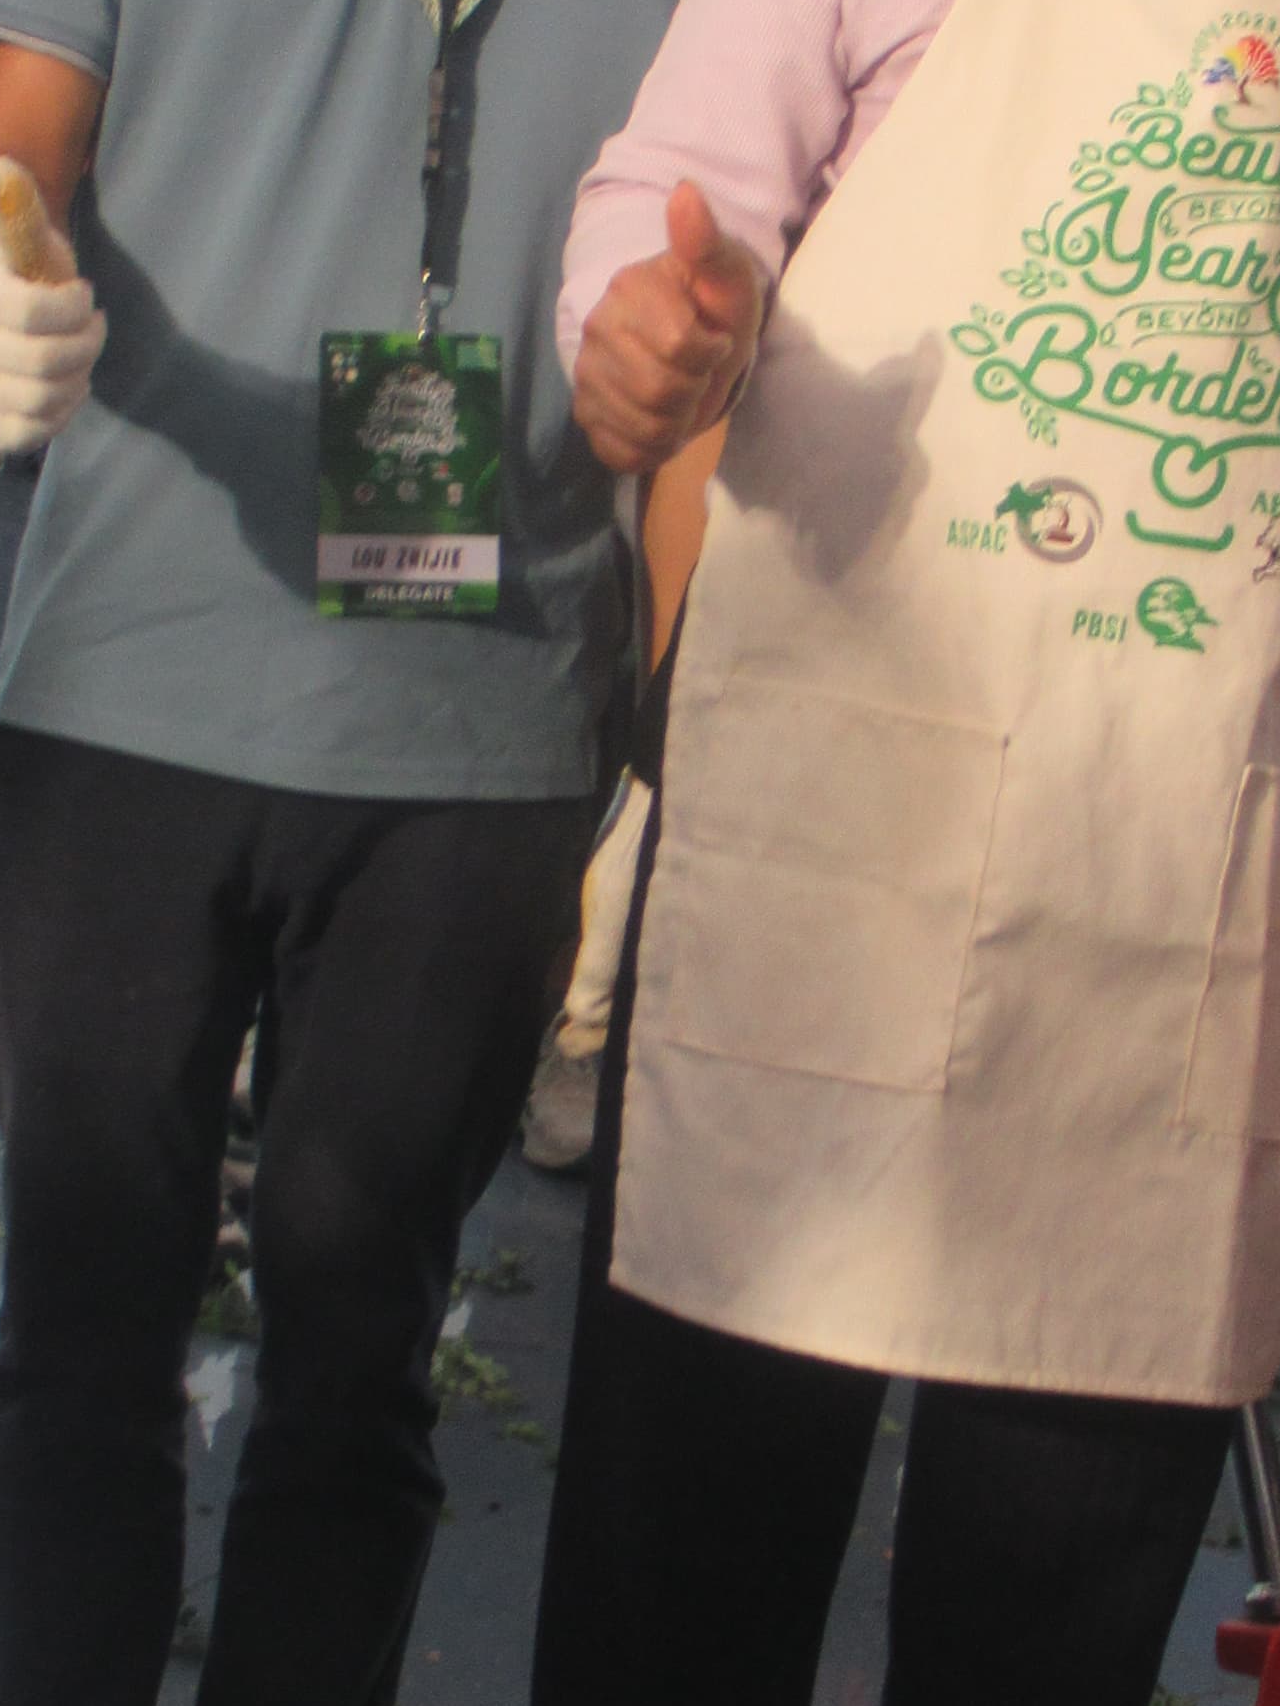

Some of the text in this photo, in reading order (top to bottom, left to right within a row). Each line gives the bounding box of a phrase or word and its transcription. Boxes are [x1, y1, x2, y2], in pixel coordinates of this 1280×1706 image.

[1136, 306, 1252, 329] BEYOND
[946, 516, 1009, 554] ASPAC
[366, 584, 455, 604] DELEGATE
[1072, 608, 1129, 644] PBSI
